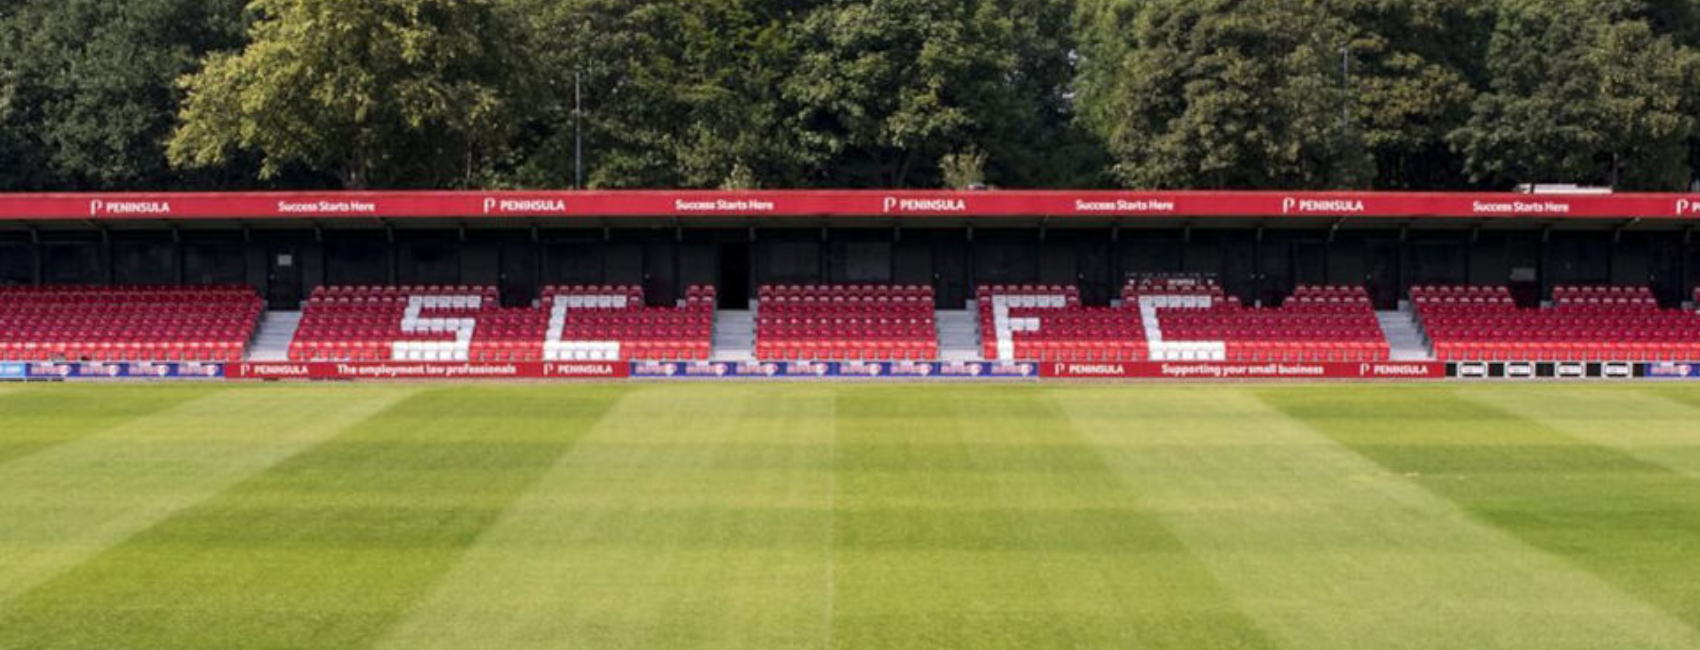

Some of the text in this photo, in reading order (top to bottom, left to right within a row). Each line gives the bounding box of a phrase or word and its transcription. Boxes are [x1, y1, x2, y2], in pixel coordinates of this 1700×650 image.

[105, 202, 170, 213] PENINSULA
[278, 201, 375, 212] Success Starts Here
[499, 199, 565, 211] PENINSULA
[675, 199, 774, 211] Success Starts Here
[900, 199, 965, 211] PENINSULA
[1075, 199, 1174, 211] Success Starts Here
[1299, 200, 1364, 211] PENINSULA
[1473, 201, 1569, 212] Success Starts Here
[253, 364, 309, 375] PENINSULA
[337, 363, 517, 377] The employment law professionals
[557, 364, 613, 374] PENINSULA
[1068, 364, 1125, 374] PENINSULA
[1161, 363, 1324, 377] Supporting your small business
[1373, 364, 1429, 374] PENINSULA
